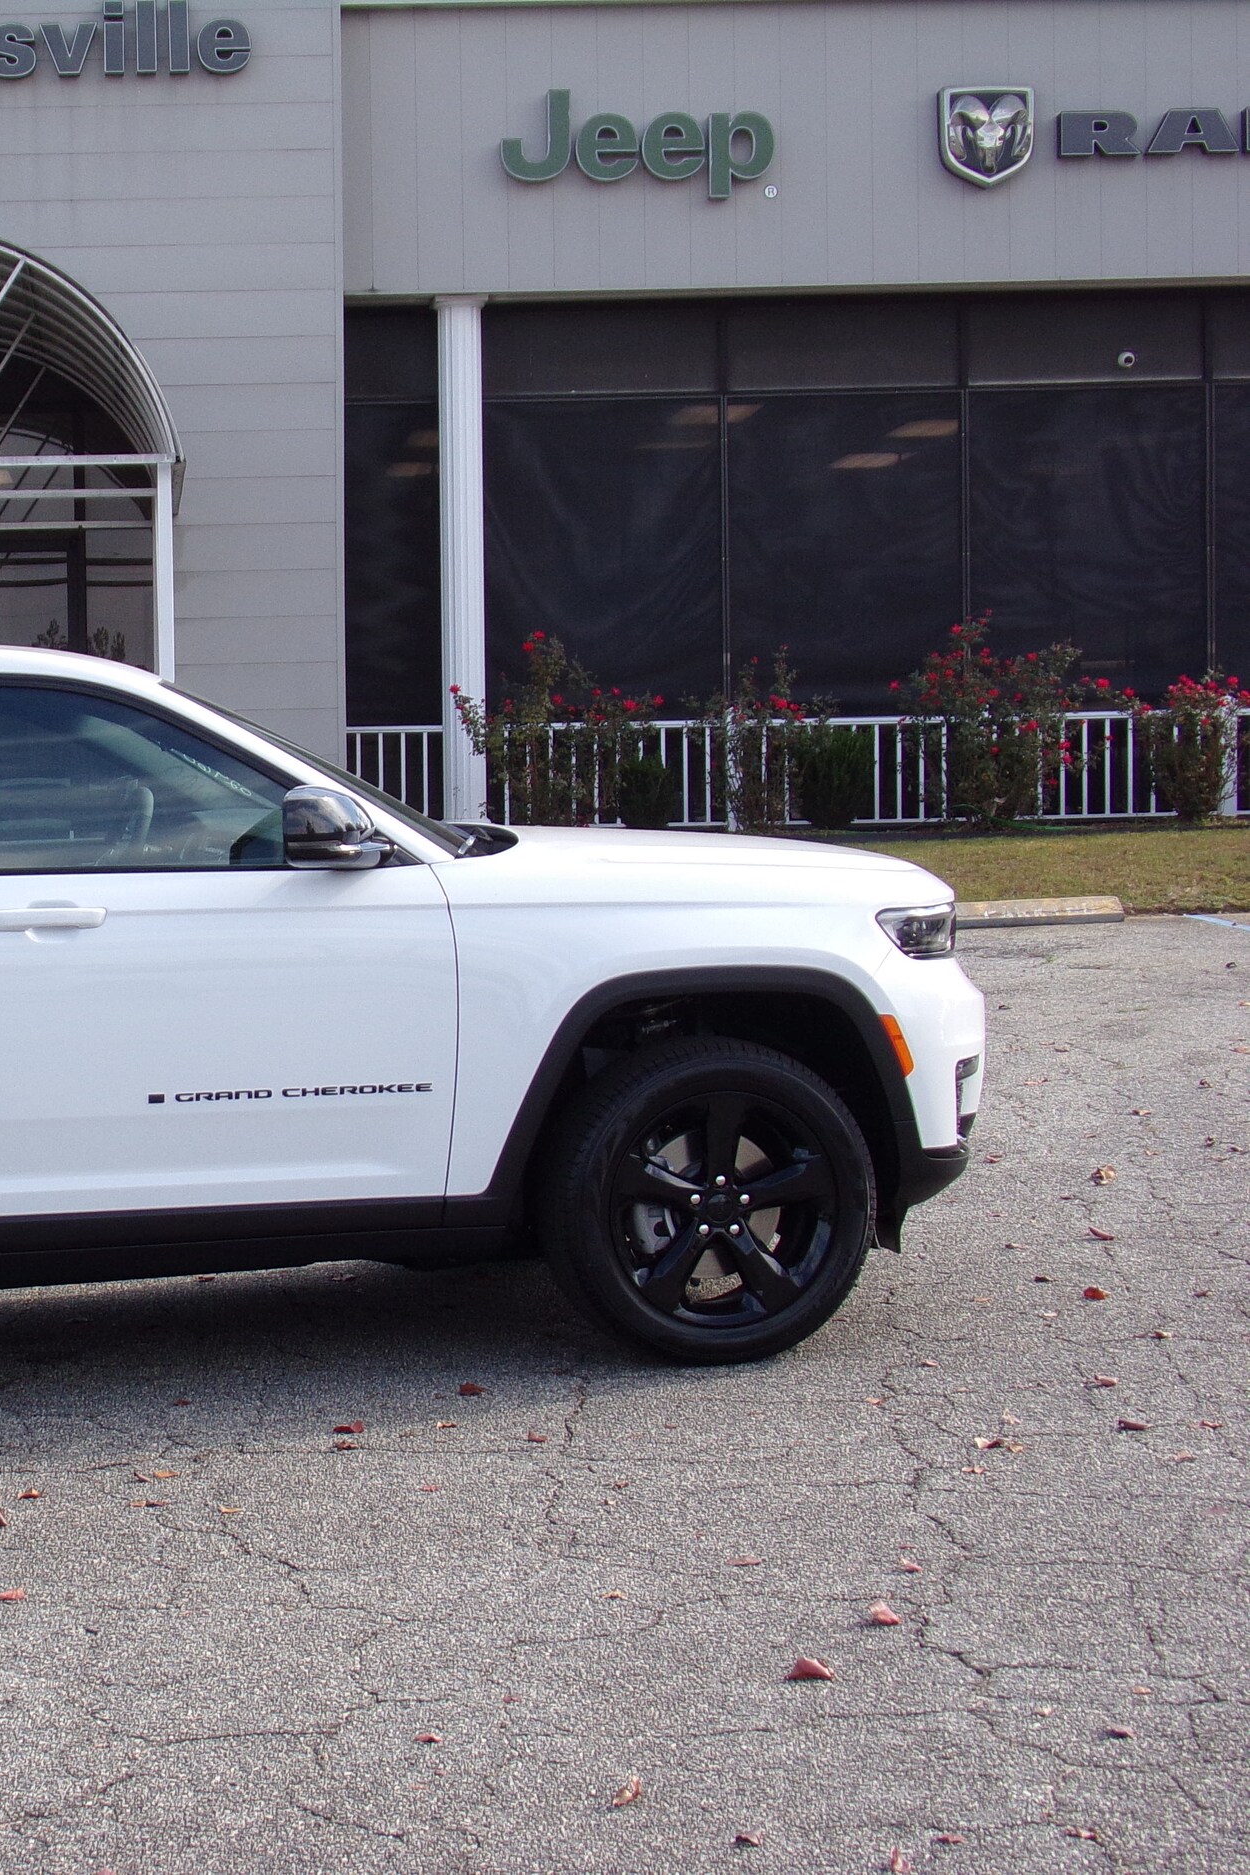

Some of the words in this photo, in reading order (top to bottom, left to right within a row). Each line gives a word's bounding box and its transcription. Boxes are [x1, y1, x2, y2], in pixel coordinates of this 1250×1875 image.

[500, 88, 775, 201] Jeep
[1056, 106, 1250, 158] RA
[174, 1088, 273, 1103] GRAND
[281, 1082, 434, 1098] CHEROKEE
